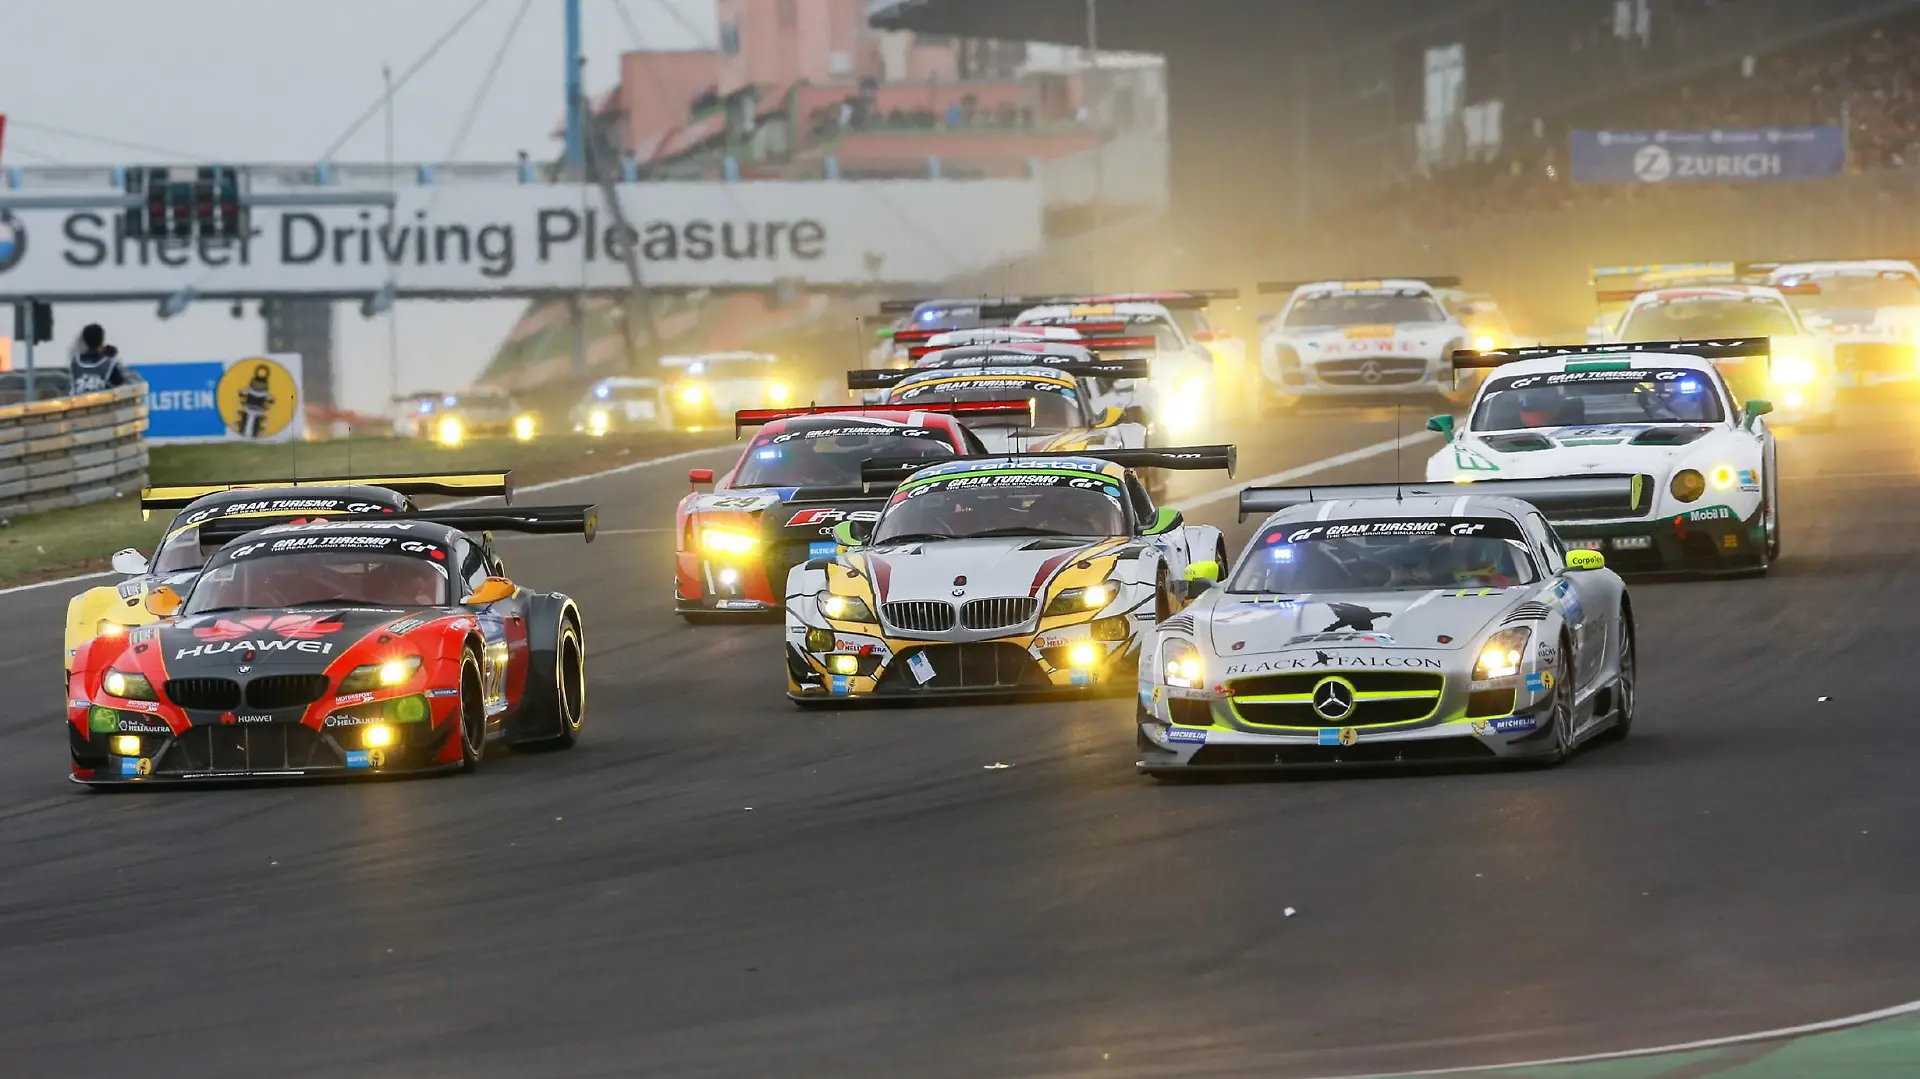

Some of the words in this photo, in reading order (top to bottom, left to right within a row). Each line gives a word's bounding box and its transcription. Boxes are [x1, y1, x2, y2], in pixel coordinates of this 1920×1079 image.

[1676, 153, 1781, 177] ZURICH
[280, 210, 516, 277] Driving
[537, 208, 826, 262] Pleasure
[1549, 372, 1584, 382] GRAN
[935, 381, 970, 391] GRAN
[972, 379, 1026, 388] TURISMO
[146, 389, 214, 411] ILSTEIN
[806, 428, 839, 438] GRAN
[971, 461, 1097, 472] randstad
[948, 476, 992, 487] GRAN
[994, 475, 1060, 484] TURISMO
[226, 501, 269, 513] GRAN
[272, 499, 337, 508] TURISMO
[1690, 509, 1718, 521] Mobil
[1326, 524, 1369, 535] GRAN
[1372, 522, 1438, 532] TURISMO
[272, 537, 319, 548] GRAN
[320, 537, 391, 545] TURISMO
[175, 639, 333, 660] HUAWEI
[1226, 659, 1307, 675] BLACK
[1336, 656, 1442, 668] FALCON
[238, 715, 272, 723] HUAWEI
[1497, 718, 1535, 728] MICHELIN
[1169, 731, 1207, 739] MICHELIN
